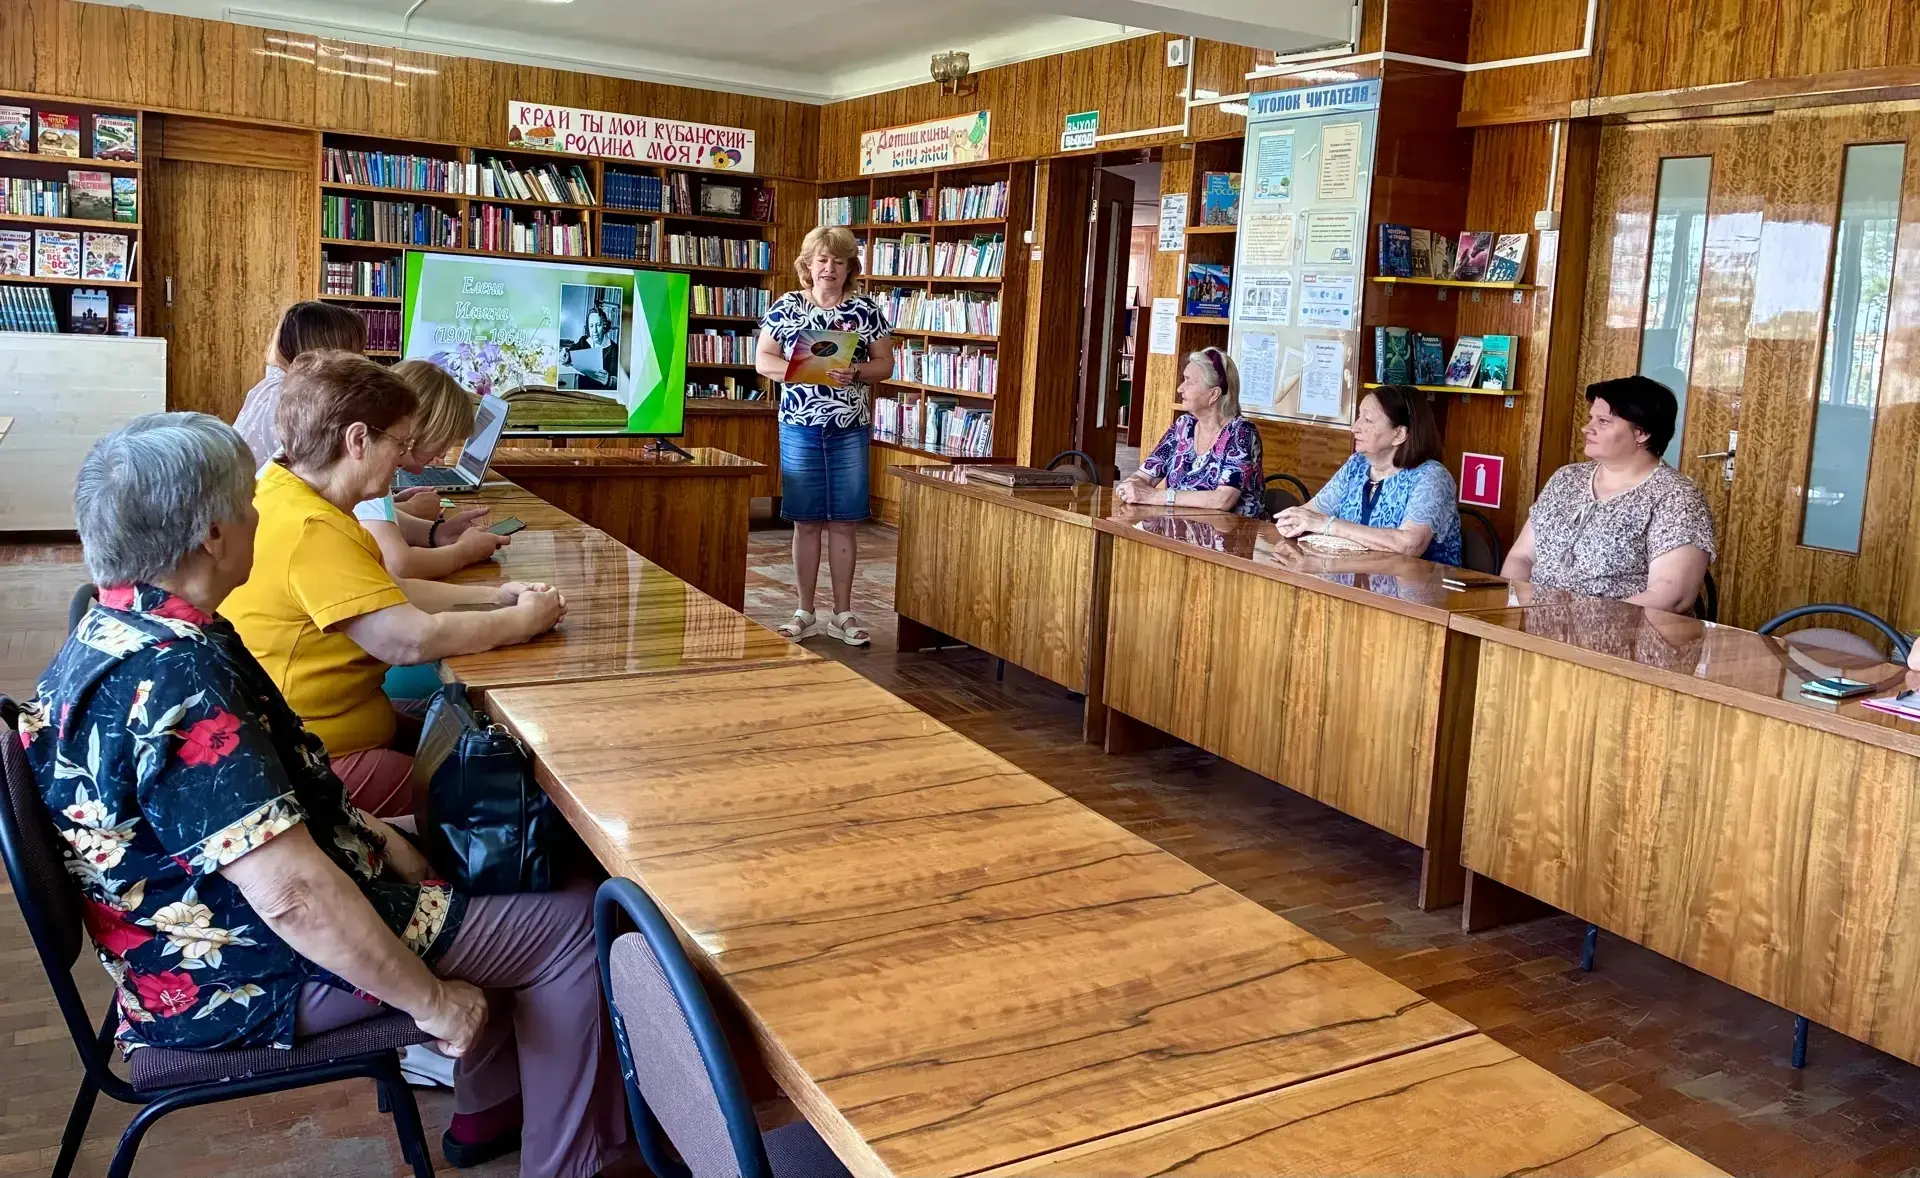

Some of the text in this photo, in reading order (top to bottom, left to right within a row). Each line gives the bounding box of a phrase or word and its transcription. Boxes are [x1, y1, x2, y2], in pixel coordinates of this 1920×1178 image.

[1257, 85, 1369, 114] УГОЛОК ЧИТАТЕЛЯ
[519, 106, 570, 130] КРАЙ
[580, 113, 603, 134] ТЫ
[609, 117, 646, 138] МОЙ
[1067, 118, 1097, 133] ВЫХОД
[565, 133, 635, 158] РОДИНА
[877, 126, 950, 155] Детишкины
[1065, 133, 1093, 147] ВЫХОД
[462, 276, 504, 296] Елена
[455, 301, 509, 321] Ильина
[433, 325, 473, 345] (1901
[489, 328, 527, 348] 1964)
